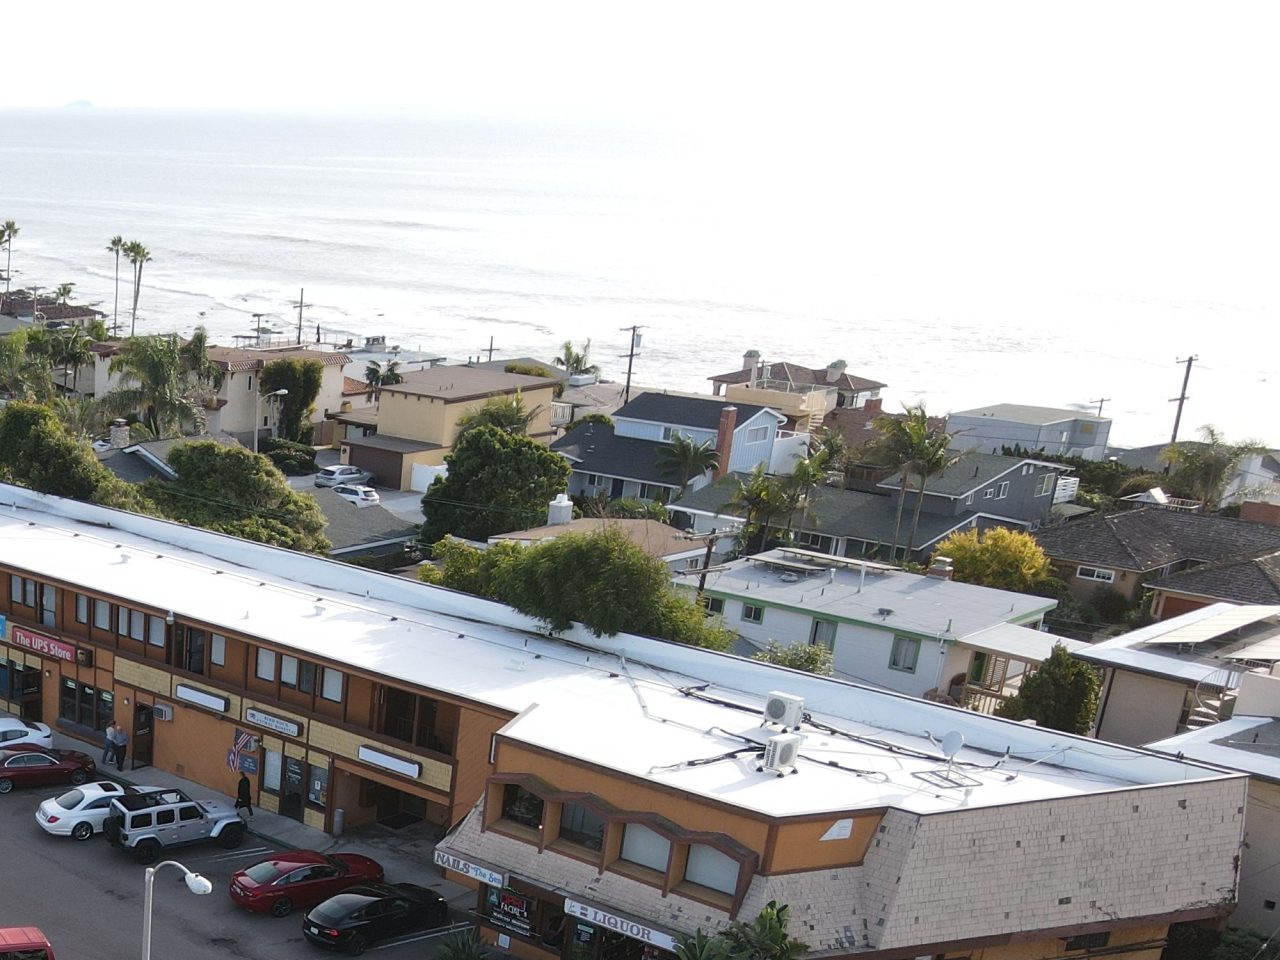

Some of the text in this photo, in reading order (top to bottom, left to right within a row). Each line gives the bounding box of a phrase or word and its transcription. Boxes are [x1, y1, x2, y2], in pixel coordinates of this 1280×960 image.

[15, 631, 71, 660] The UPS Store
[436, 852, 470, 874] NAILS
[474, 867, 487, 880] The
[592, 910, 652, 941] LIQUOR
